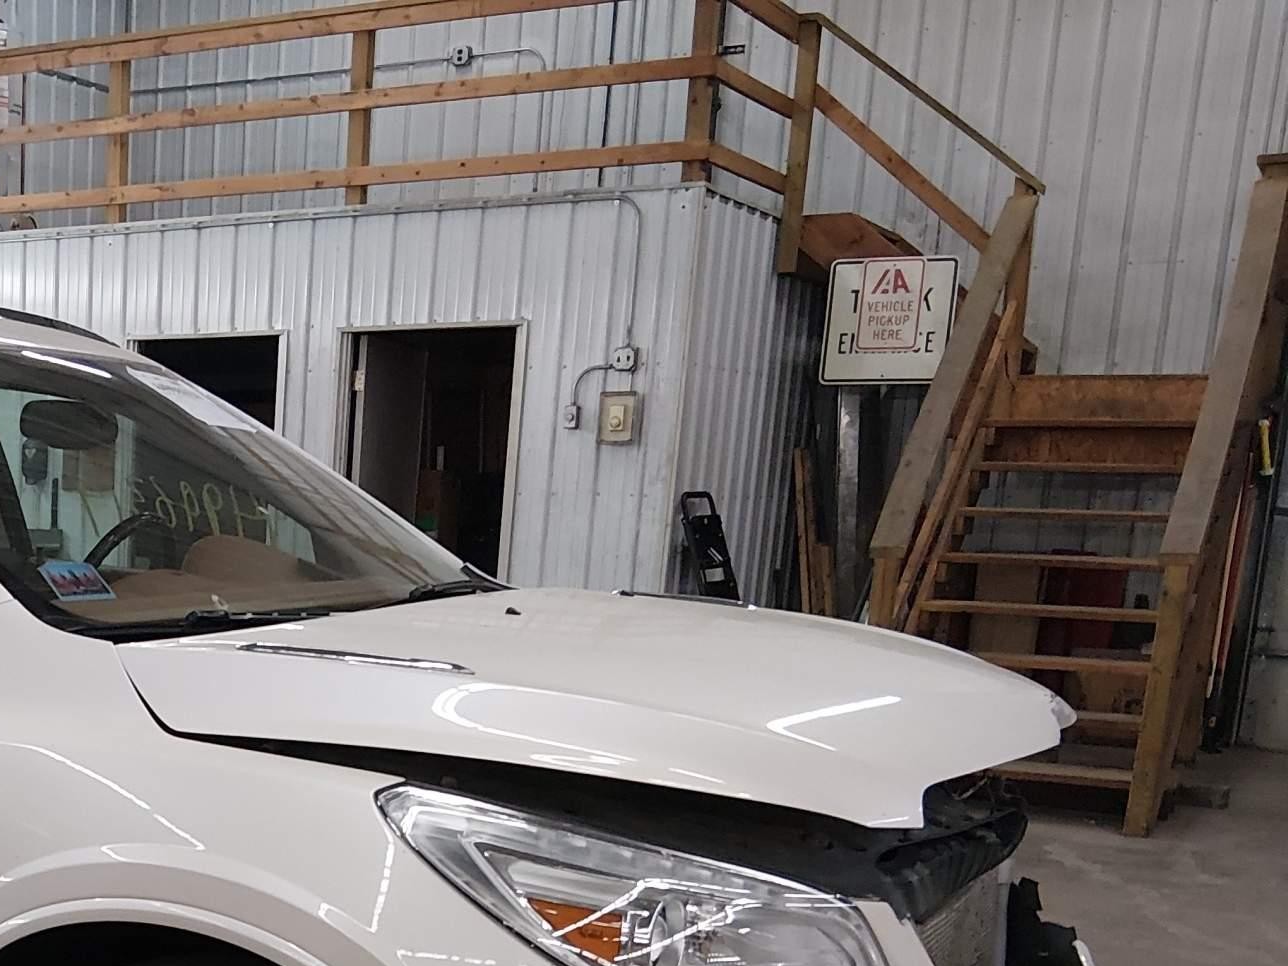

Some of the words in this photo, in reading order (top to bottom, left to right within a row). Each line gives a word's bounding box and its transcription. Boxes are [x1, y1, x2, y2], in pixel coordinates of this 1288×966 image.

[867, 300, 914, 313] VEHICLE
[867, 314, 910, 327] PICKUP
[872, 329, 903, 341] HERE
